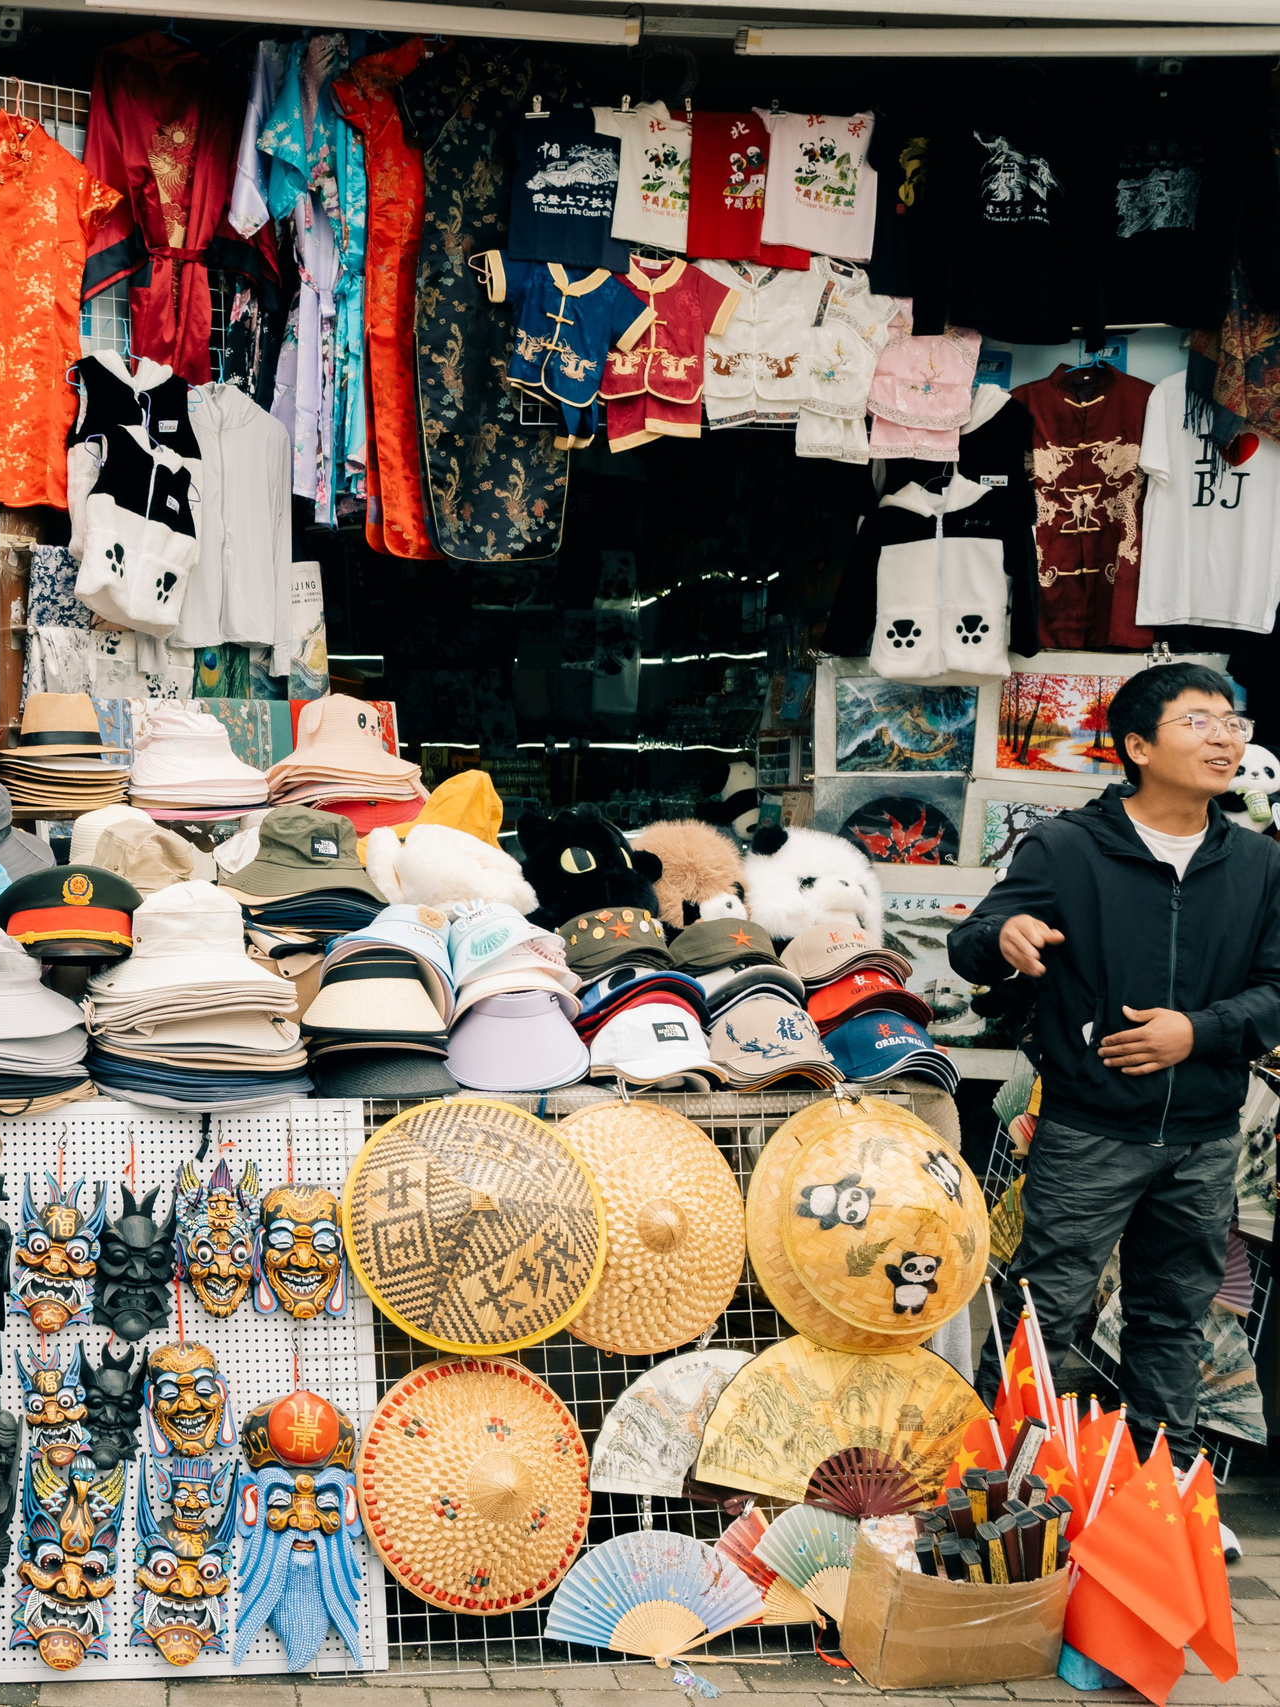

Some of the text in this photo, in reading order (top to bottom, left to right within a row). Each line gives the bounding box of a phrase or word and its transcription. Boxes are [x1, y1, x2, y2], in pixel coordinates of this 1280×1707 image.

[730, 121, 750, 139] 北
[807, 114, 868, 138] 北京
[539, 205, 568, 215] Climbed
[569, 207, 581, 215] The
[582, 208, 601, 217] Great
[666, 210, 677, 218] Wall
[1192, 471, 1251, 509] BJ
[850, 984, 892, 996] GREATW
[874, 1036, 927, 1050] GREATWALL
[45, 1206, 77, 1239] 福
[37, 1370, 58, 1393] 福
[176, 1531, 205, 1557] 福
